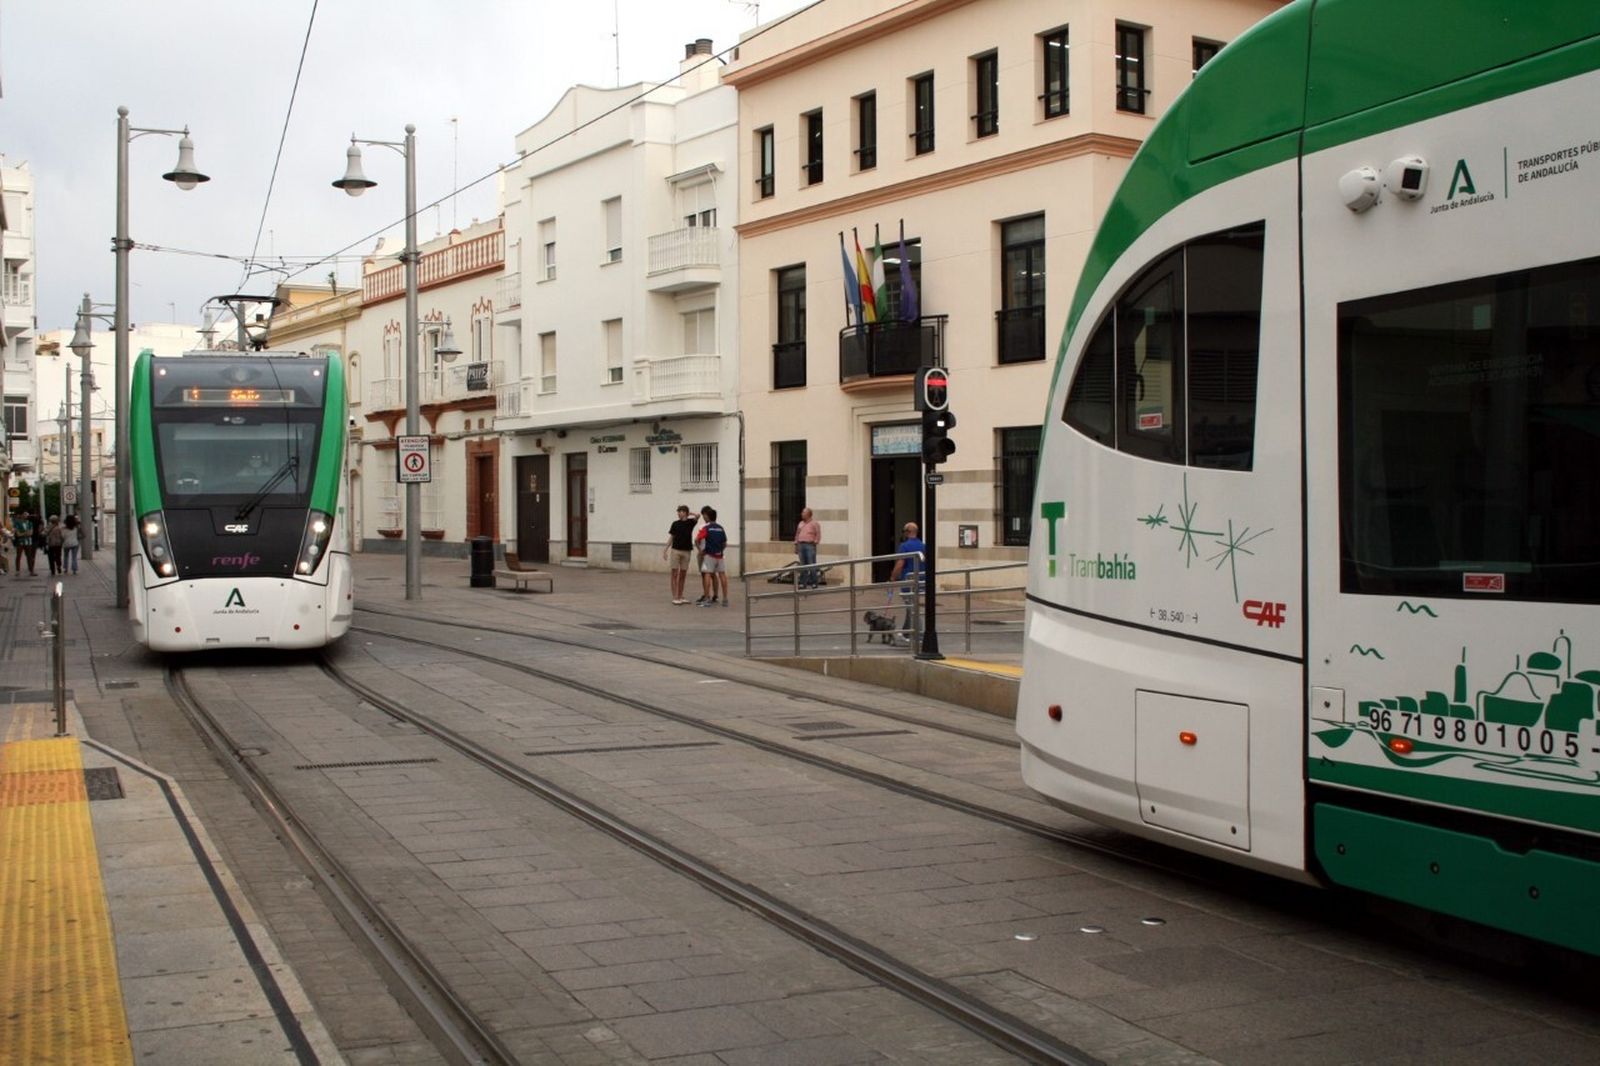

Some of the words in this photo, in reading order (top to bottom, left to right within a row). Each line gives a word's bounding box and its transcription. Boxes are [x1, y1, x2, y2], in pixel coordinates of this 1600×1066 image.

[1518, 147, 1579, 170] TRANSPORTES
[1581, 140, 1600, 154] PÚB
[1518, 173, 1529, 183] DE
[1531, 160, 1579, 181] ANDALUCÍA
[1430, 202, 1449, 214] Junta
[1450, 200, 1459, 210] de
[1460, 191, 1494, 207] Andalucía
[224, 524, 248, 533] CAF
[211, 552, 260, 570] renfe
[1069, 553, 1136, 581] Trambahía
[1158, 609, 1184, 623] 38.540
[1242, 599, 1287, 628] CAF
[1370, 709, 1391, 732] 96
[1401, 713, 1422, 735] 71
